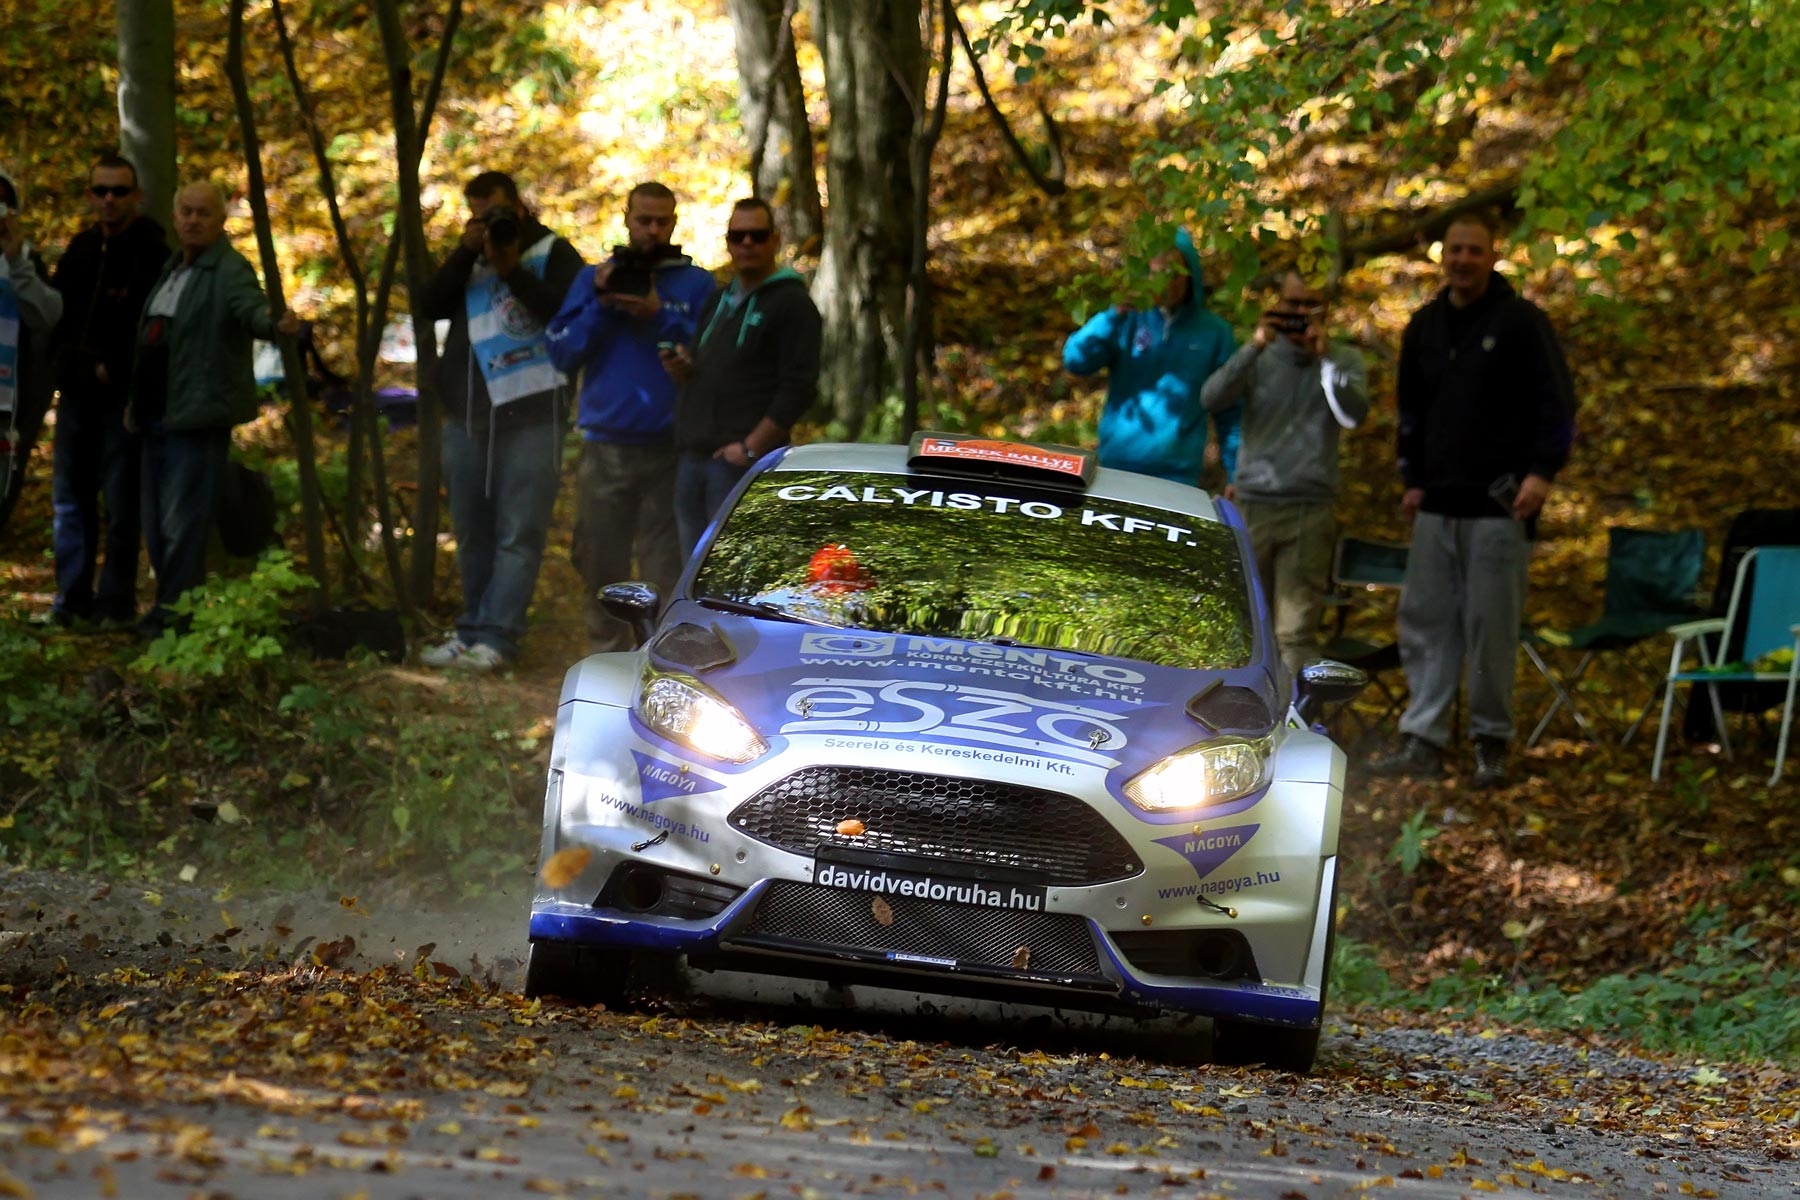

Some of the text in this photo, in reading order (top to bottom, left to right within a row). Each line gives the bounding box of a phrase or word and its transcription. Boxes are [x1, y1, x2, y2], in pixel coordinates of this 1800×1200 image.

[927, 444, 1003, 457] MECSEK
[1007, 452, 1075, 470] RALLYE
[777, 485, 1197, 547] CALYISTO KFT.
[800, 657, 1143, 706] www.mentokft.hu
[1106, 682, 1145, 696] KFT.
[894, 741, 916, 753] és
[920, 744, 1041, 769] Kereskedelmi
[1045, 760, 1076, 777] Kft.
[642, 763, 697, 793] NAGOYA
[600, 792, 711, 844] www.nagoya.hu
[1184, 834, 1242, 854] NAGOYA
[817, 865, 1041, 912] davidvedoruha.hu
[1157, 871, 1281, 900] www.nagoya.hu
